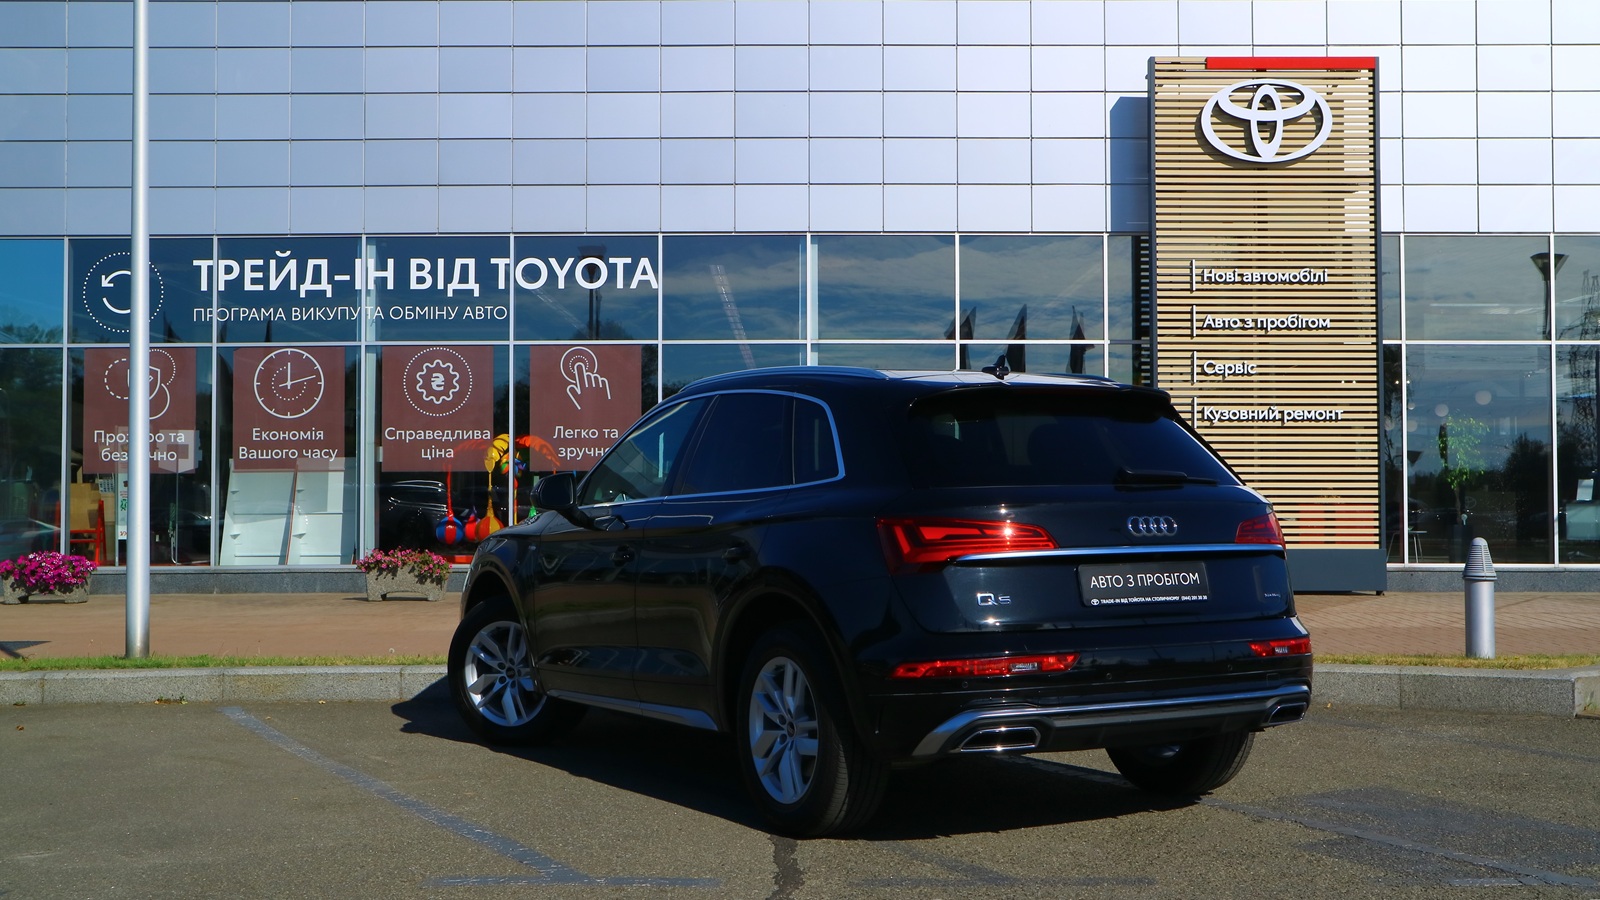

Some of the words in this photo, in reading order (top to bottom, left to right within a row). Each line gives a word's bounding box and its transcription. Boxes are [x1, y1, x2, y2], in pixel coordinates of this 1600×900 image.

[193, 251, 394, 297] ТРЕЙД-ІН
[410, 258, 479, 297] ВІД
[491, 257, 659, 289] TOYOTA
[1203, 268, 1238, 283] Нові
[1243, 268, 1328, 283] автомобілі
[193, 307, 286, 322] ПРОГРАМА
[292, 306, 361, 321] ВИКУПУ
[365, 306, 385, 320] ТА
[389, 305, 459, 320] ОБМІНУ
[463, 305, 508, 320] АВТО
[1203, 314, 1240, 328] Авто
[1244, 318, 1252, 328] з
[1257, 314, 1331, 332] пробігом
[1203, 360, 1257, 377] Сервіс
[1203, 405, 1280, 423] Кузовний
[1284, 409, 1343, 423] ремонт
[94, 430, 165, 446] Проо
[169, 432, 185, 443] та
[252, 427, 324, 441] Економія
[384, 427, 491, 443] Справедлива
[553, 426, 598, 439] Легко
[603, 428, 619, 439] та
[101, 448, 177, 461] безчно
[239, 447, 298, 460] Вашого
[302, 449, 338, 462] часу
[421, 445, 454, 460] ціна
[558, 447, 611, 460] зручн
[1091, 575, 1123, 588] АВТО
[1127, 574, 1135, 587] З
[1137, 572, 1200, 587] ПРОБІГОМ
